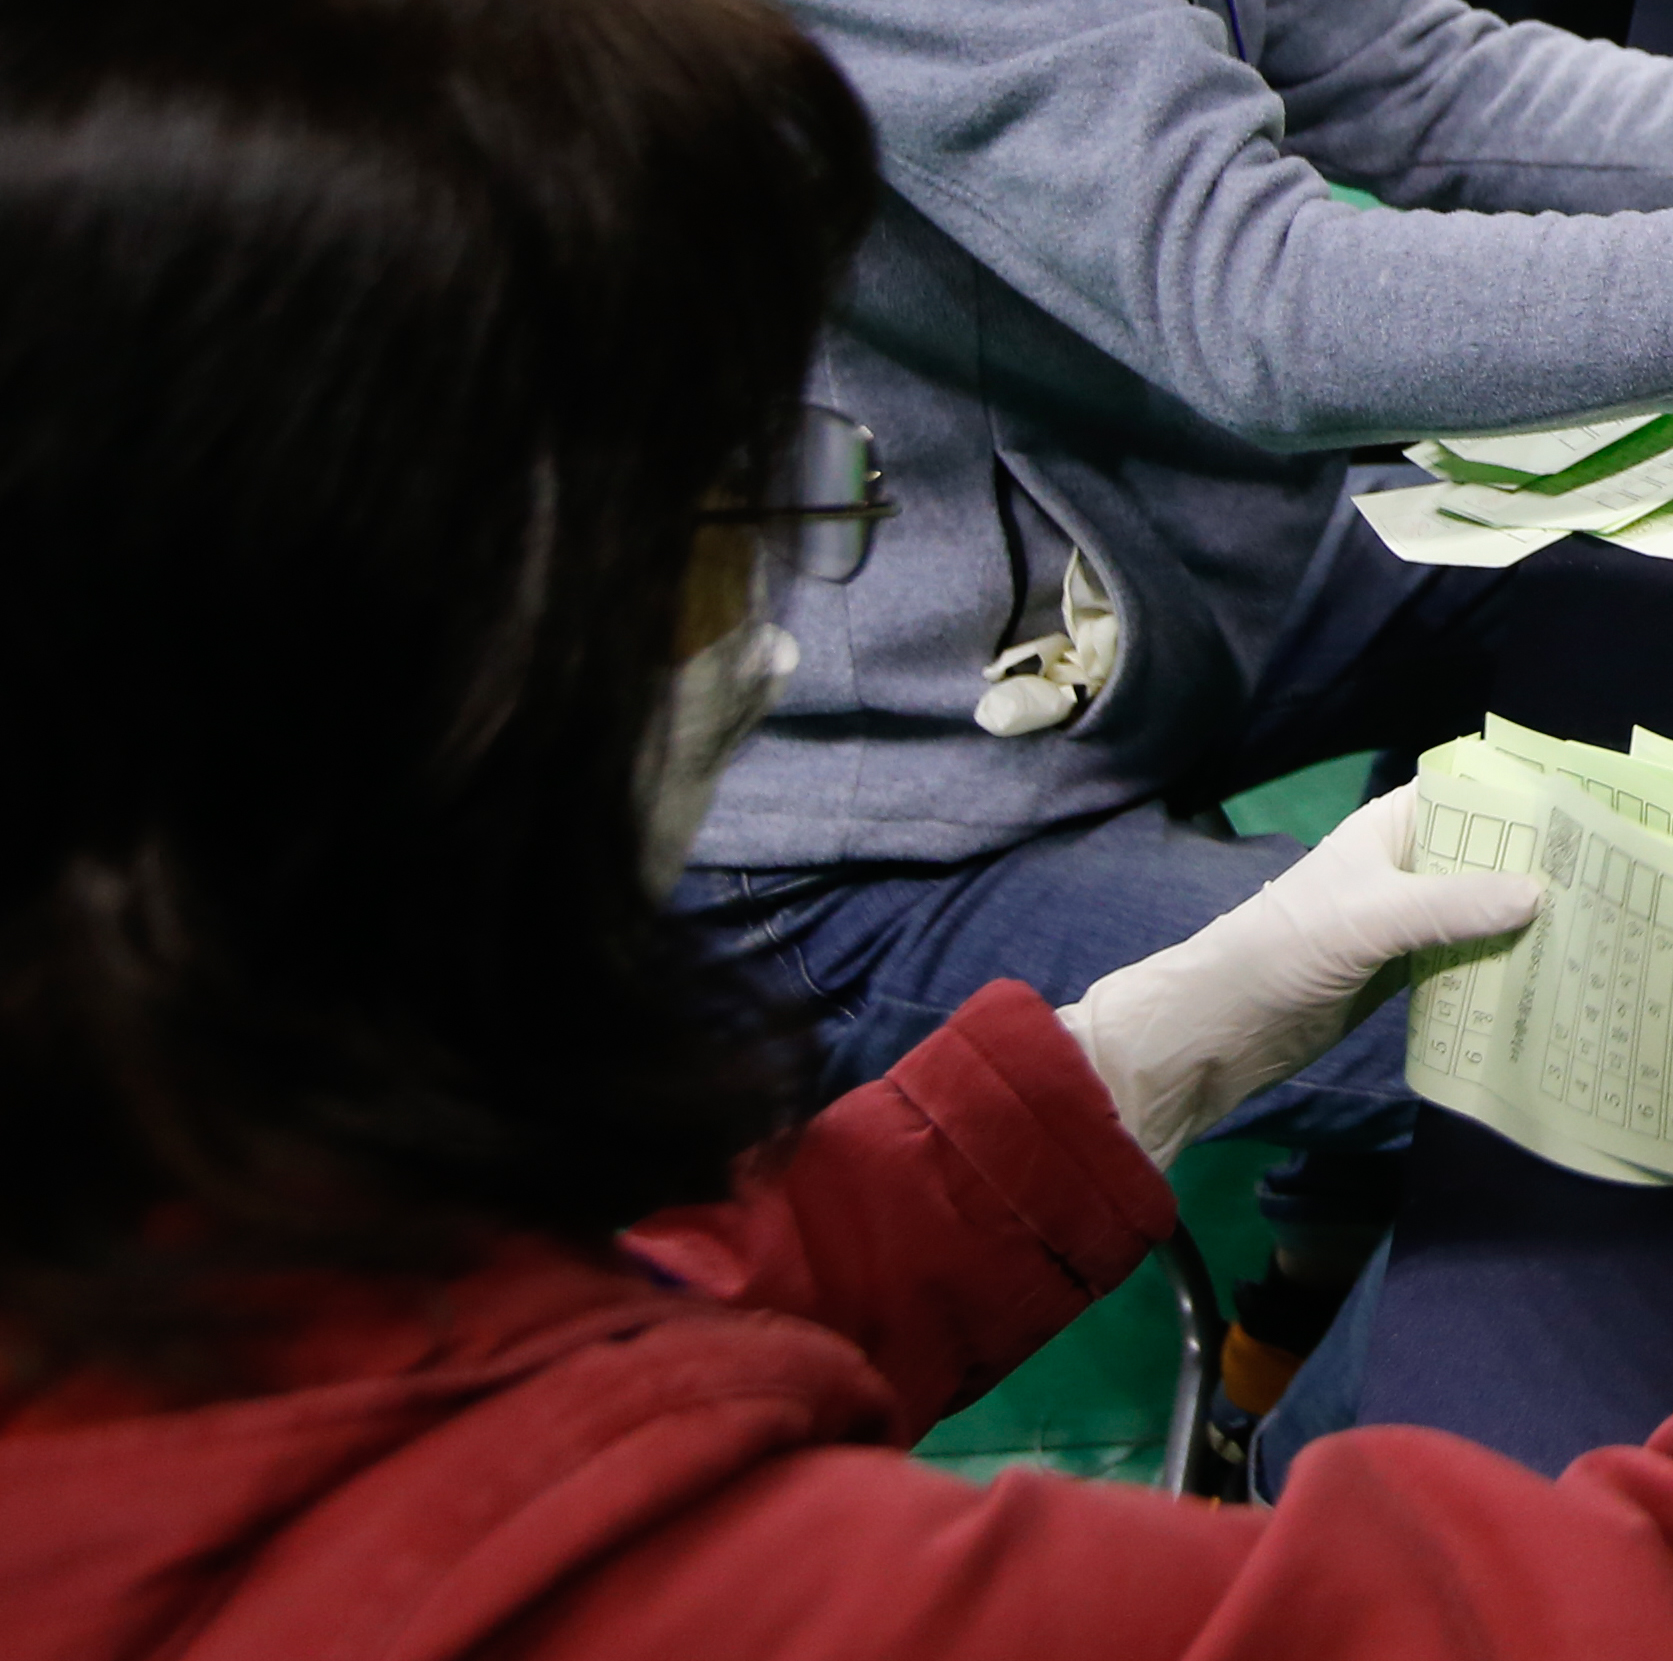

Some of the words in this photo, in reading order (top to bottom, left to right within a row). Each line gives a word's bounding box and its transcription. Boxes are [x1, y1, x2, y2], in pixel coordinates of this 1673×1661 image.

[1430, 1041, 1448, 1054] 5
[1465, 1051, 1484, 1064] 6
[1574, 1079, 1590, 1094] 4
[1604, 1091, 1620, 1107] 5
